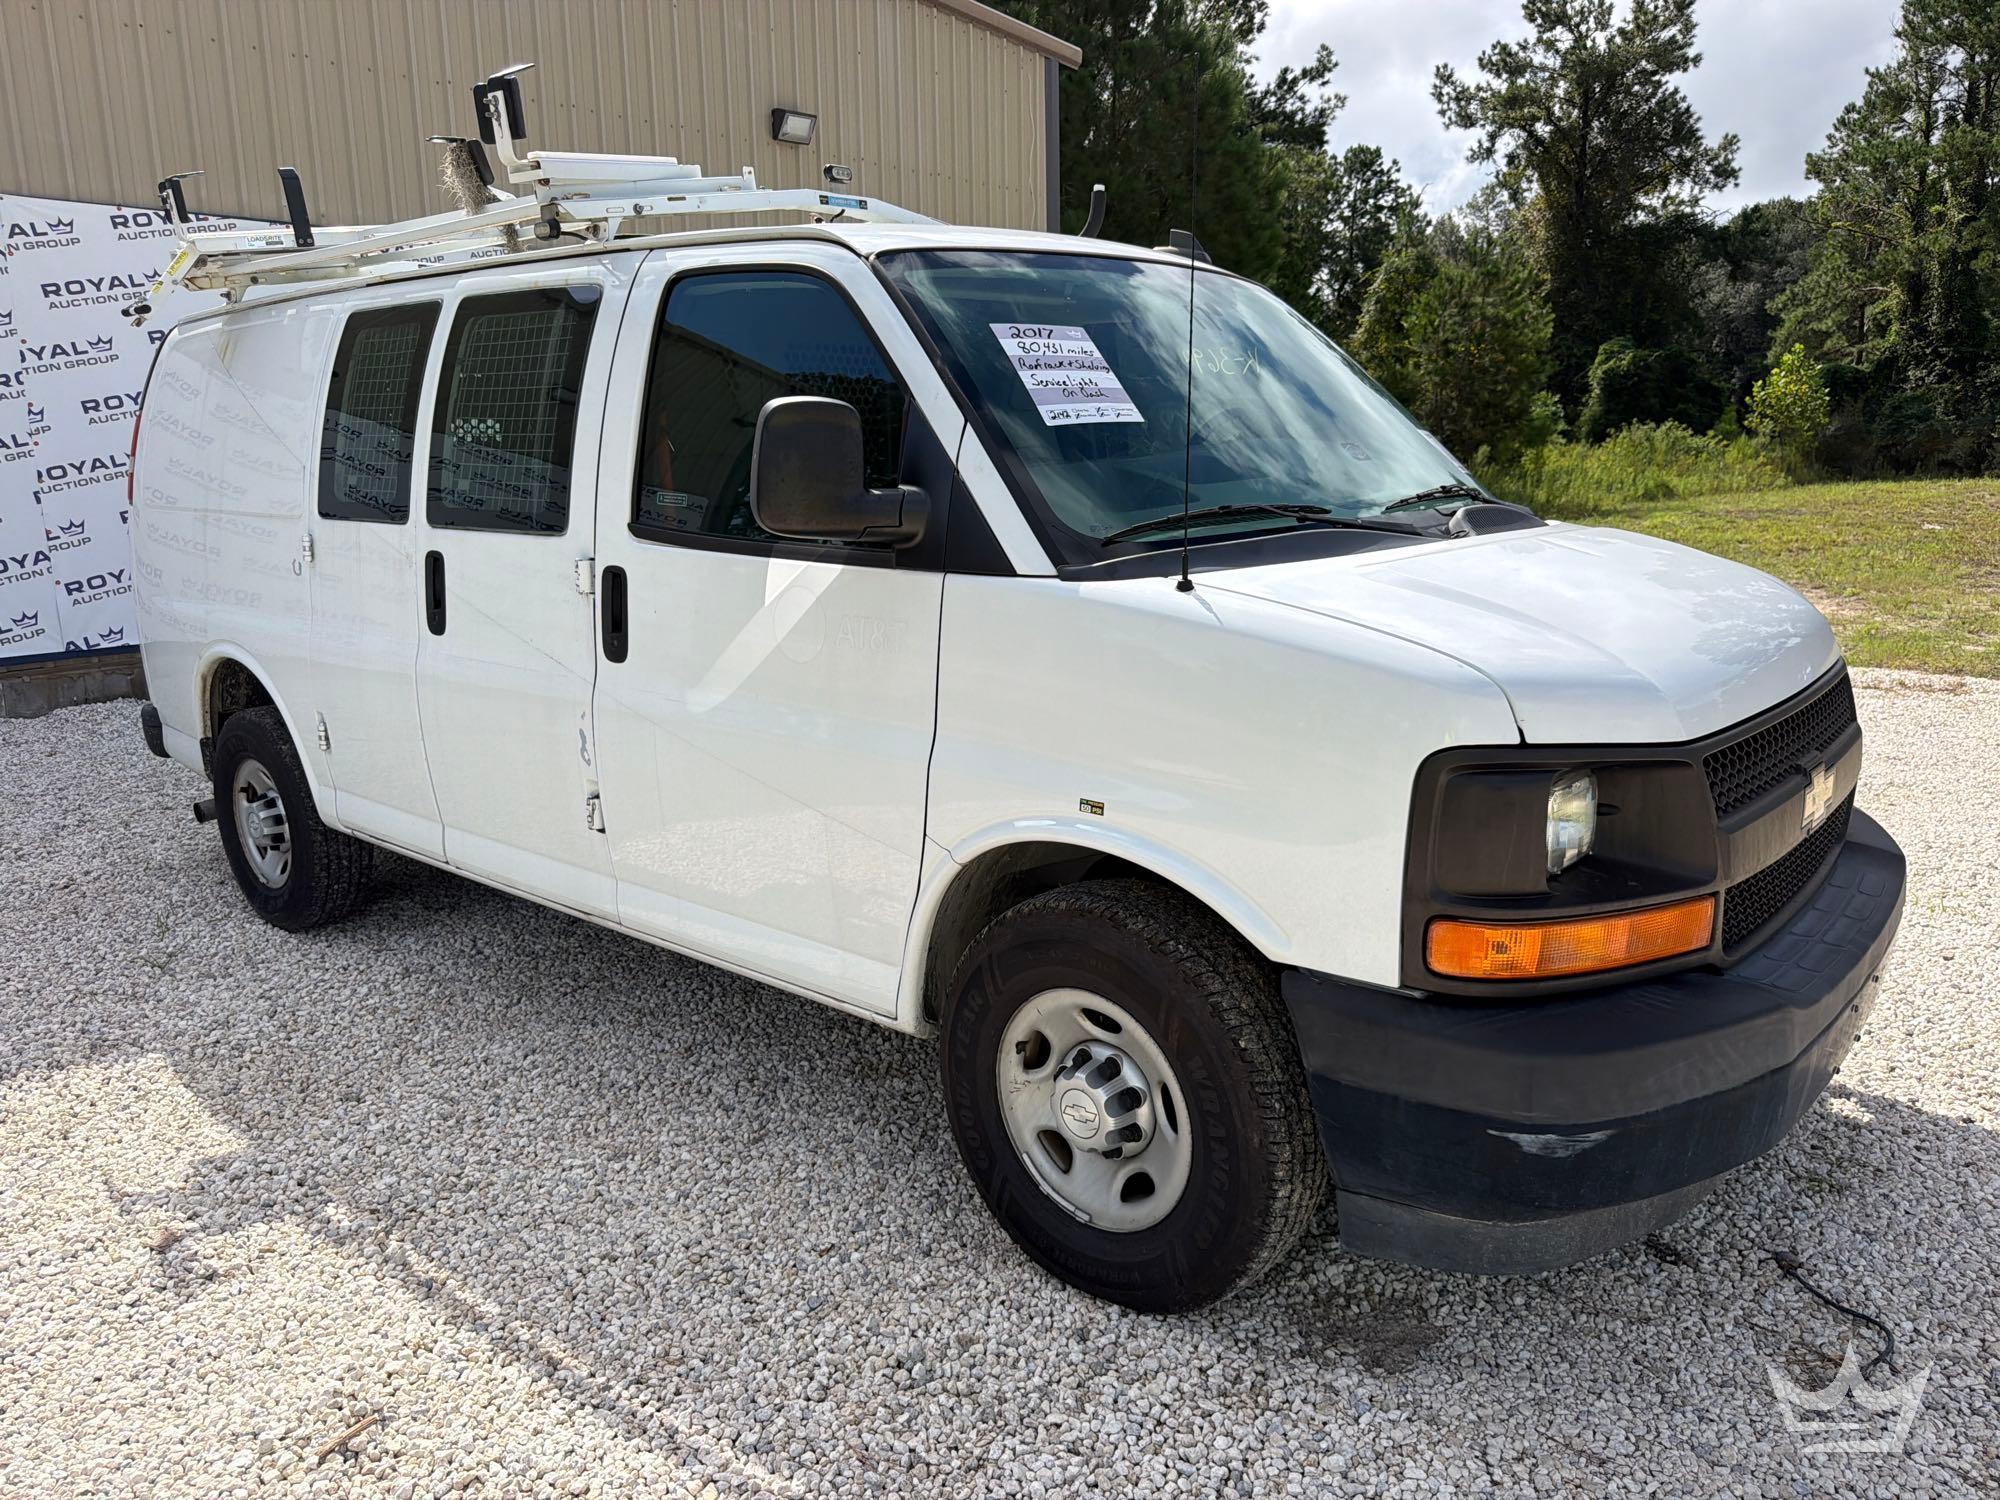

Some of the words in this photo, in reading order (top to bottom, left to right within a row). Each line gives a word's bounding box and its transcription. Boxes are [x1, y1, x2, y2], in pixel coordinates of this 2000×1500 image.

[187, 222, 237, 234] GROUP
[23, 237, 81, 250] GROUP
[40, 273, 146, 299] ROYAL
[48, 293, 119, 310] AUCTION
[1009, 325, 1053, 339] 2017
[1017, 341, 1063, 356] 80,431
[1067, 346, 1095, 357] miles
[64, 353, 120, 370] GROUP
[1062, 388, 1078, 398] On
[1080, 387, 1110, 398] Dash
[63, 567, 131, 597] ROY
